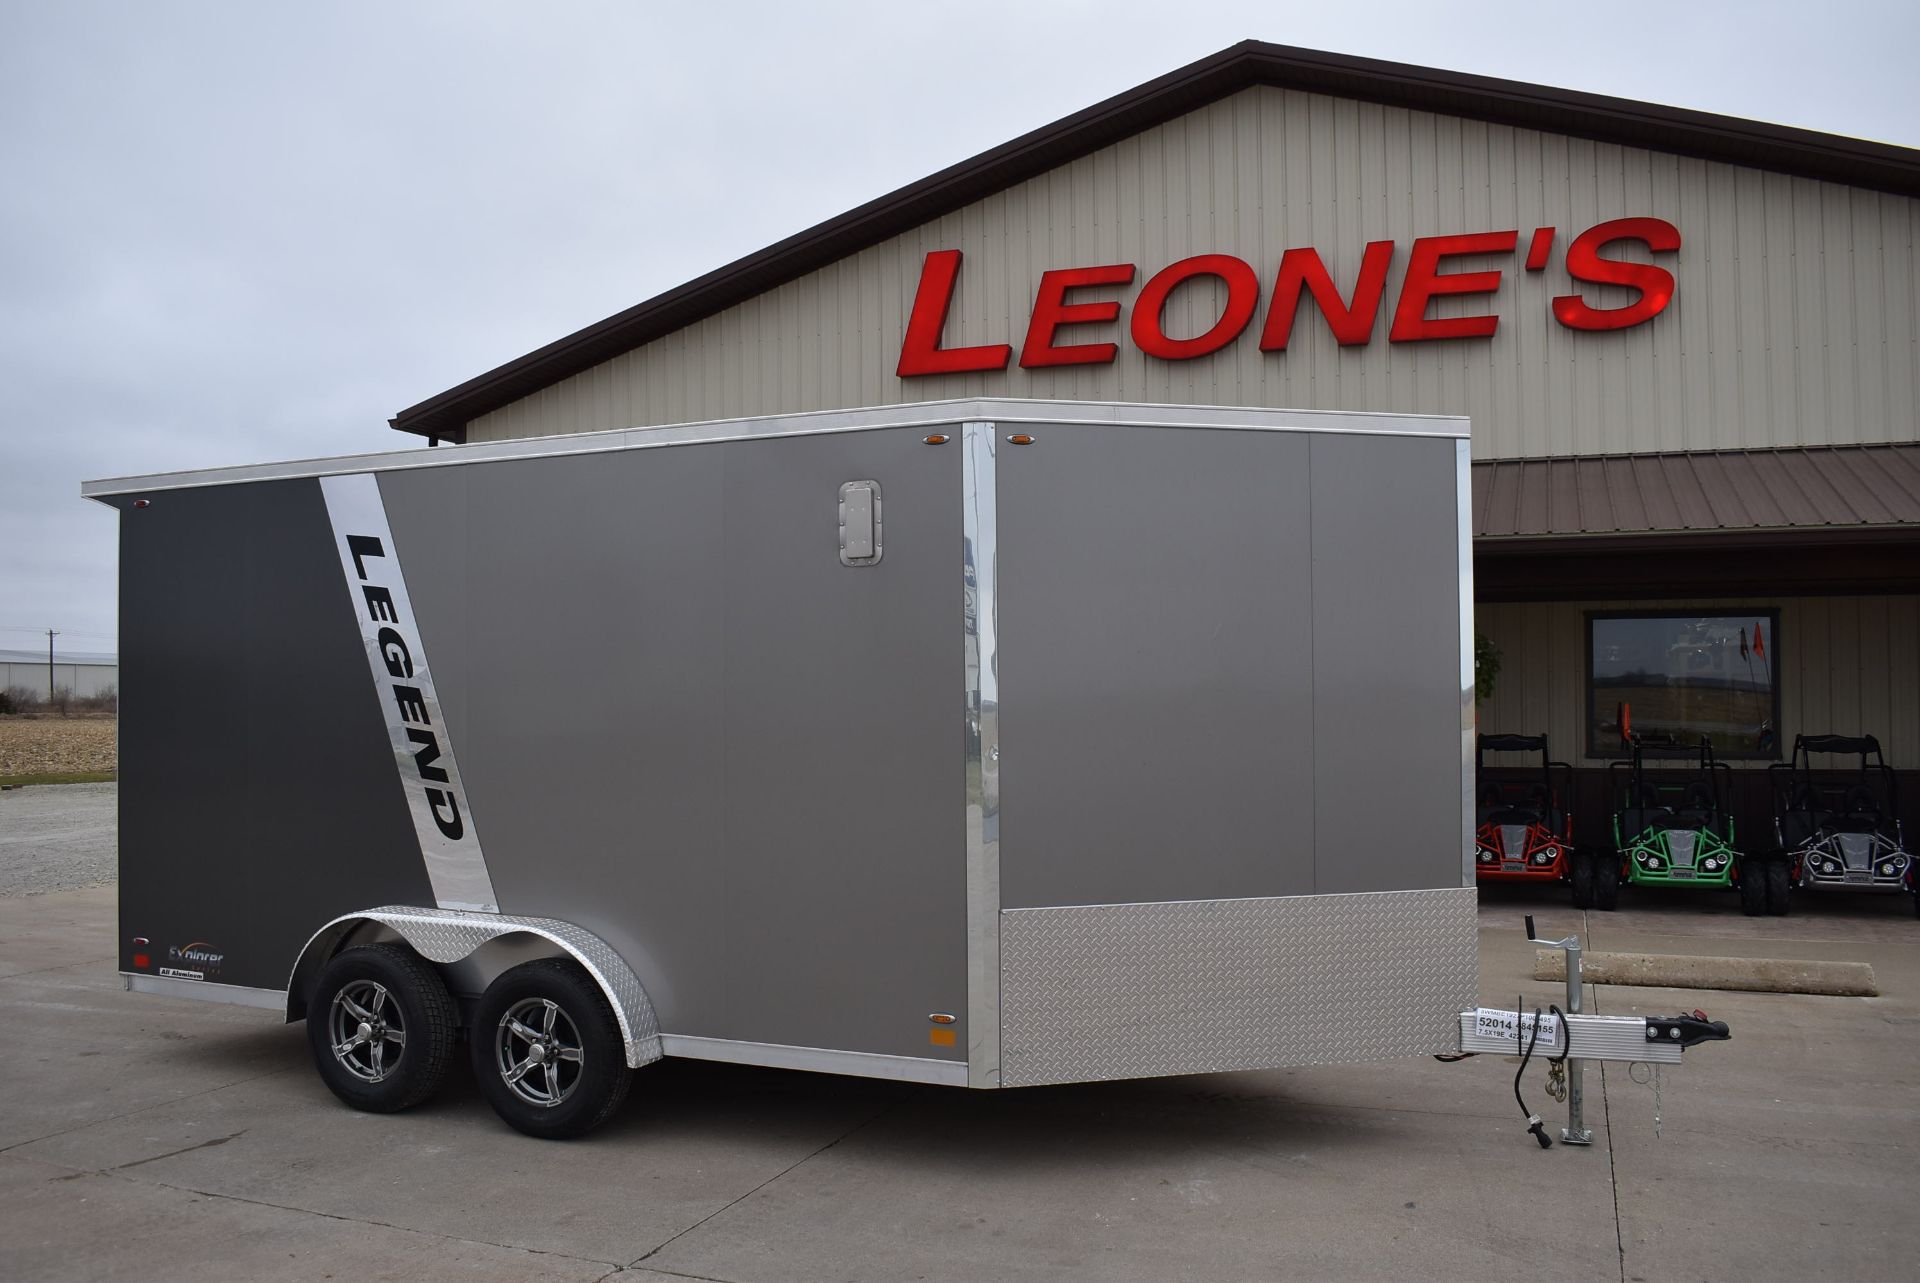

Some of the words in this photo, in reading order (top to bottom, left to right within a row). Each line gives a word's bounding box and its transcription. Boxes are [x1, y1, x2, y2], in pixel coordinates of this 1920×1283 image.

[896, 217, 1681, 378] LEONE'S
[346, 534, 463, 840] LEGEND
[172, 970, 203, 979] Aluminum
[1479, 1017, 1512, 1030] 52014
